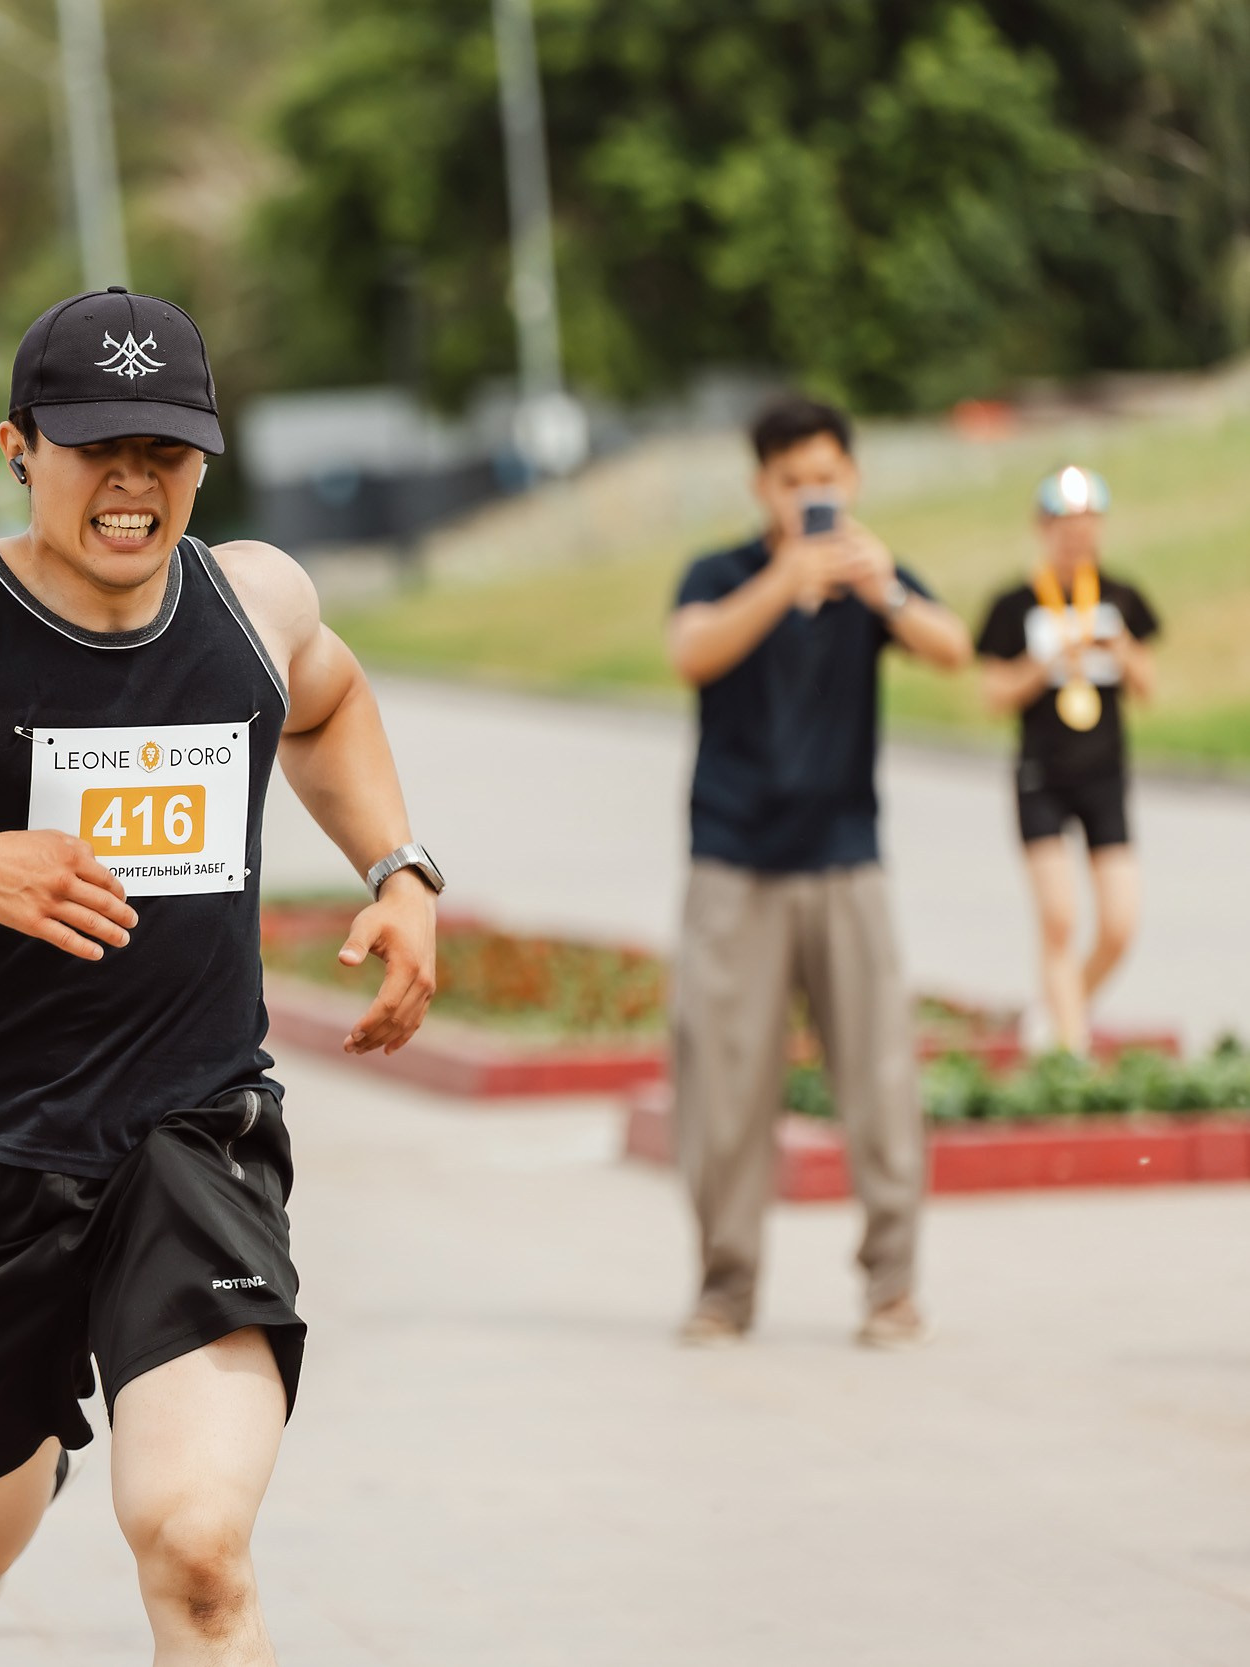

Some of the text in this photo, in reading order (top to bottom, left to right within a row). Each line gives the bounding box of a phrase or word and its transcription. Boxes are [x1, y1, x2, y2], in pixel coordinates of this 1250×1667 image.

[54, 746, 231, 770] LEONE D'ORO
[92, 794, 193, 847] 416
[109, 862, 226, 878] ОРИТЕЛЬНЫЙ ЗАБЕГ
[212, 1275, 267, 1290] POTENZ
